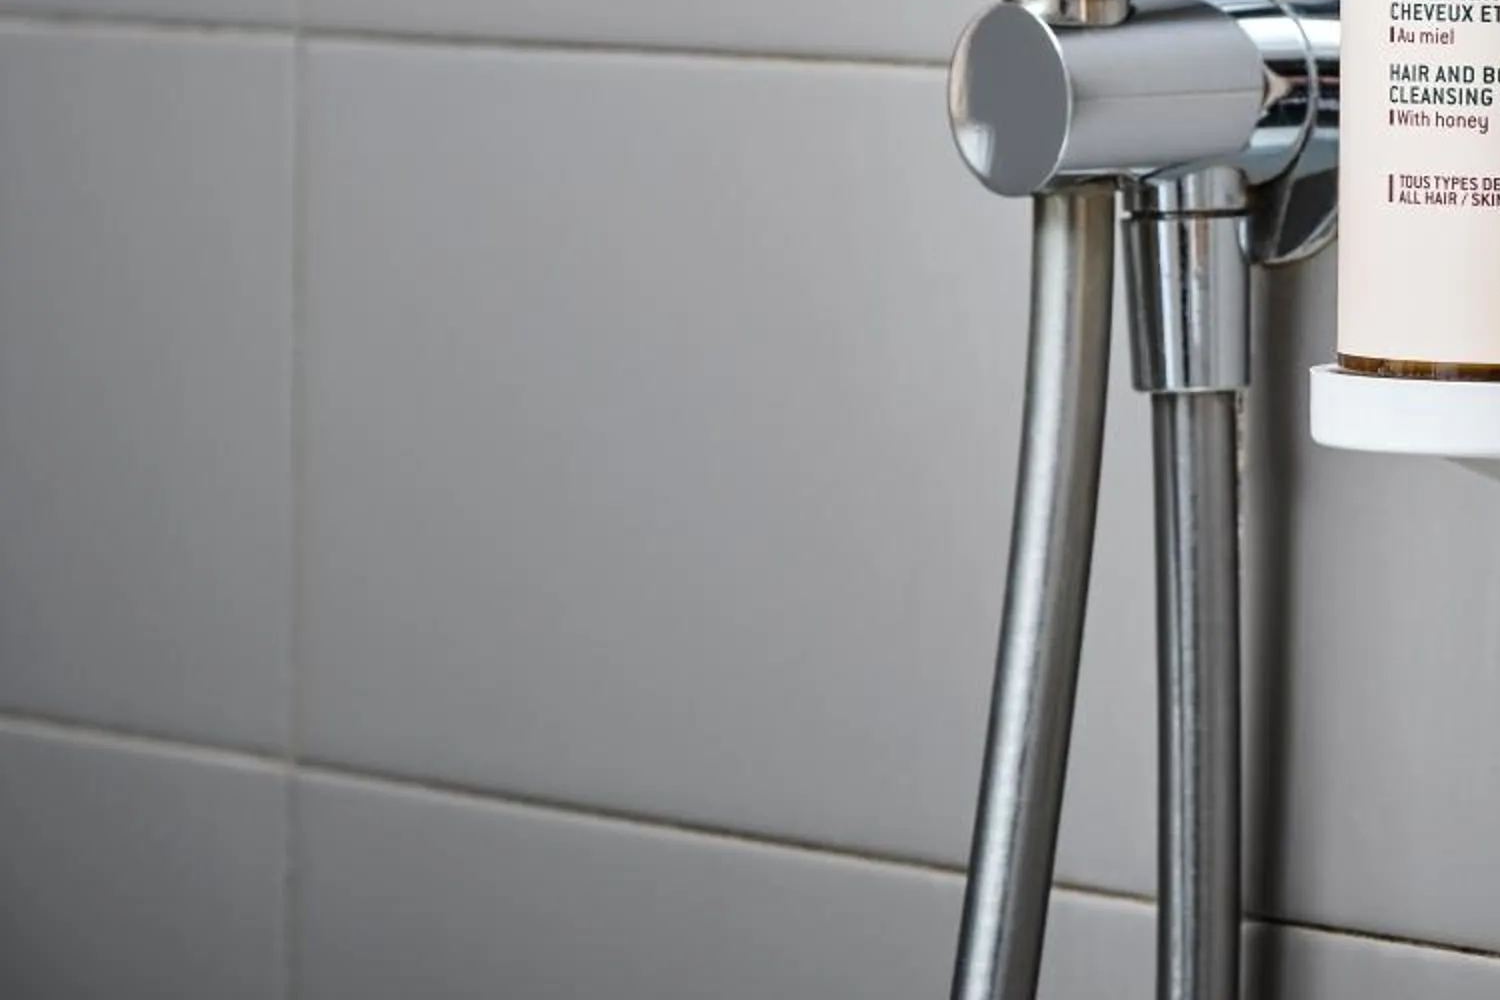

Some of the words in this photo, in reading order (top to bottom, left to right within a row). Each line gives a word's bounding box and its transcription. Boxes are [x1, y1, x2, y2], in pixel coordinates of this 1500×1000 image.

[1390, 1, 1474, 23] CHEVEUX
[1397, 27, 1416, 44] Au
[1419, 27, 1455, 45] miel
[1389, 63, 1430, 83] HAIR
[1434, 65, 1475, 85] AND
[1389, 84, 1493, 107] CLEANSING
[1397, 109, 1431, 127] With
[1435, 111, 1489, 135] honey
[1399, 173, 1431, 190] TOUS
[1433, 175, 1479, 192] TYPES
[1398, 189, 1422, 206] ALL
[1424, 191, 1458, 206] HAIR
